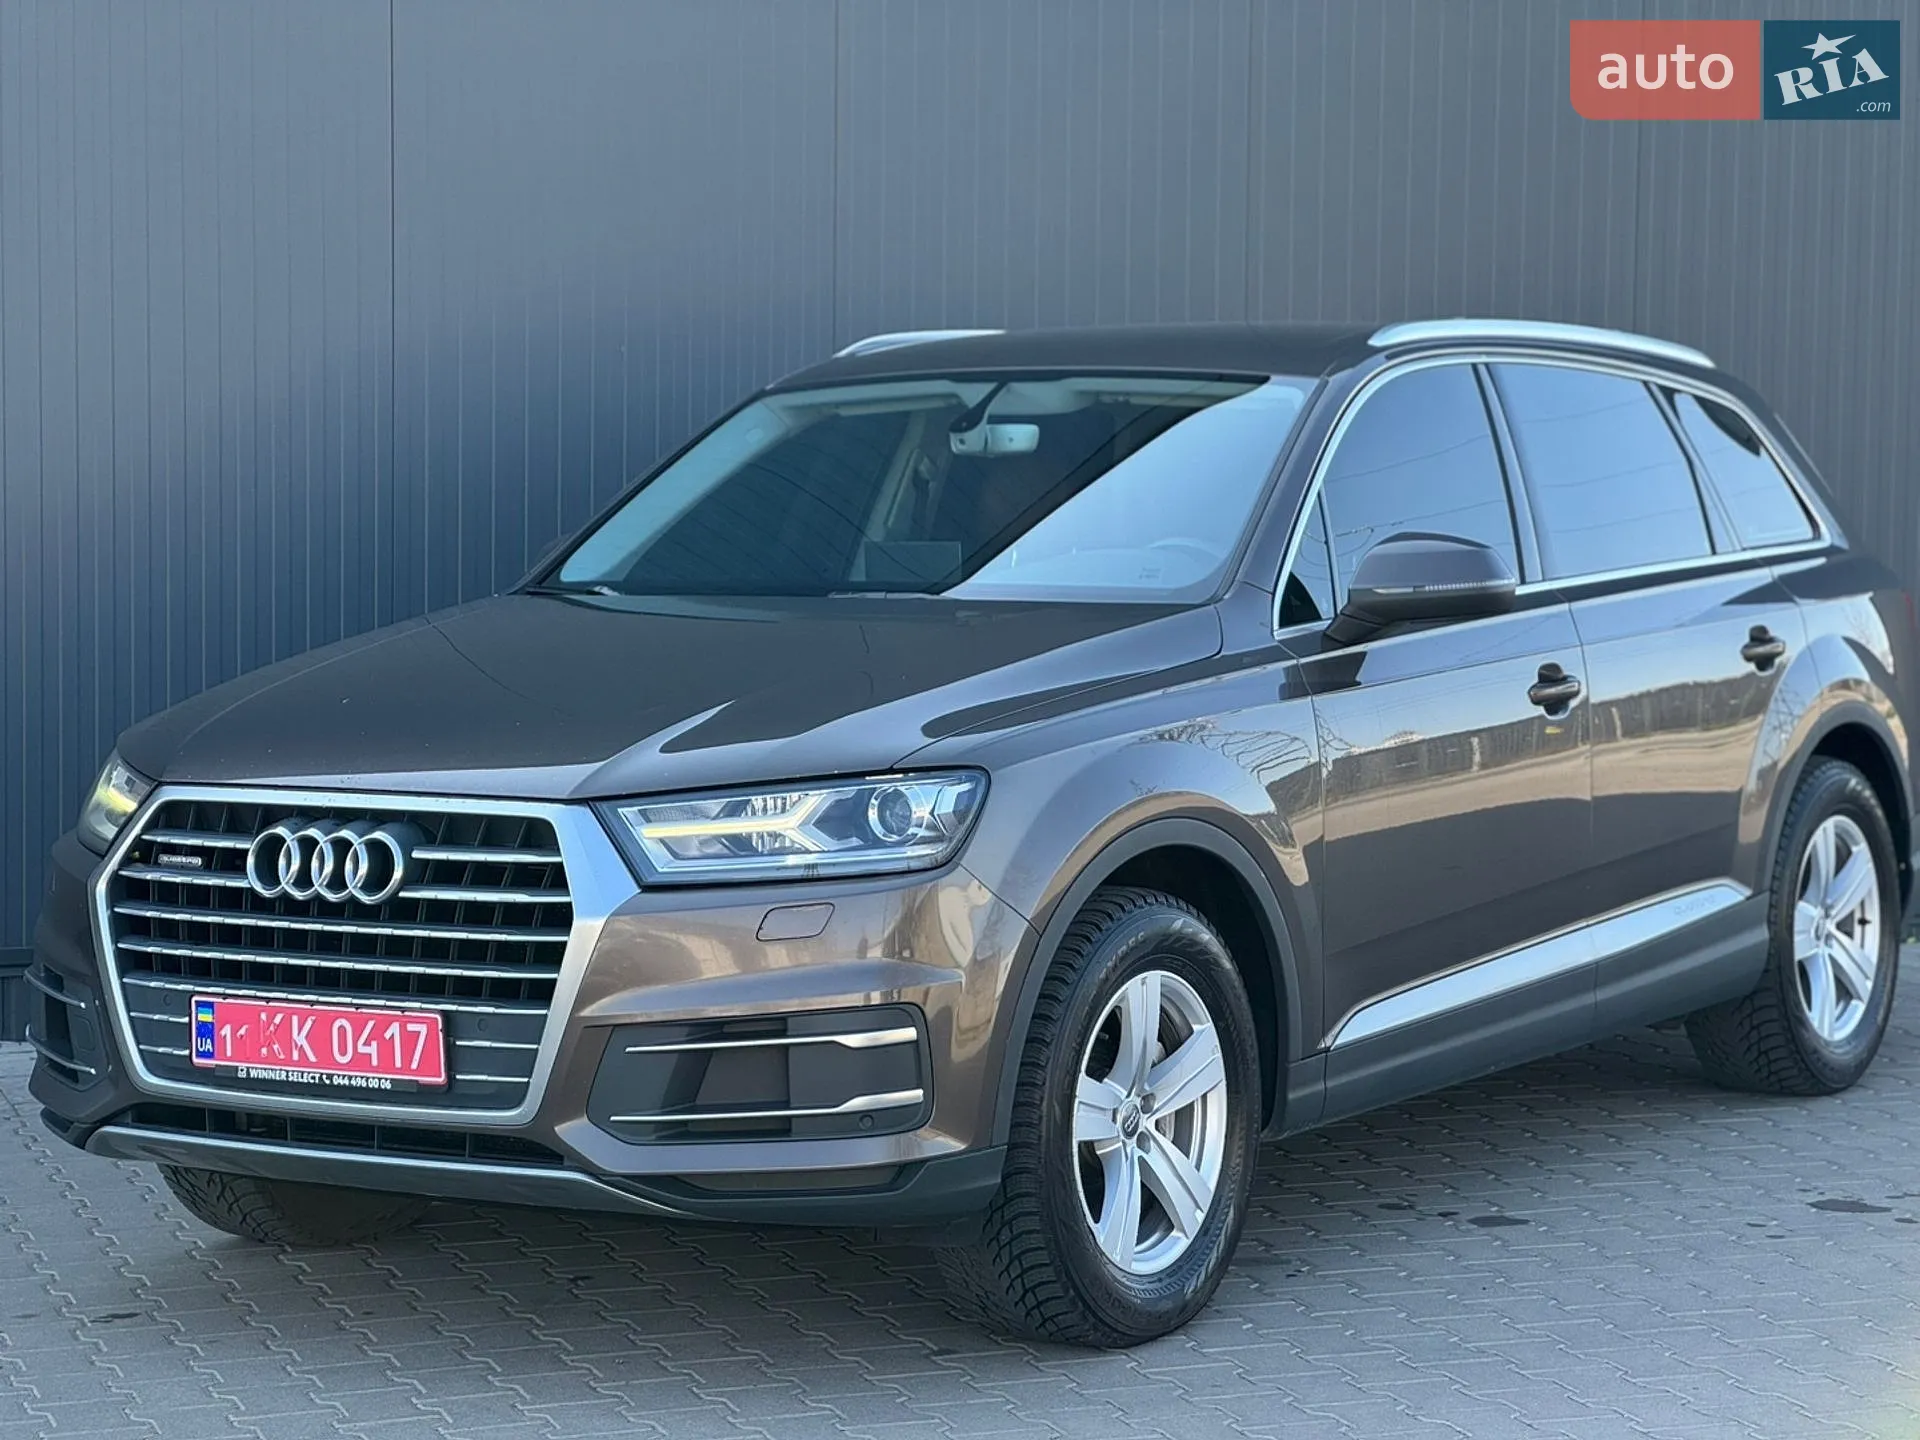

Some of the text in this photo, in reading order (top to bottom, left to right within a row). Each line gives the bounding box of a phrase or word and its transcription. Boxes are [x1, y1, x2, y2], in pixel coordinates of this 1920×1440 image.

[197, 1037, 213, 1053] UA
[331, 1018, 428, 1071] 0417
[249, 1067, 392, 1090] WINNER SELECT 044 496 00 06
